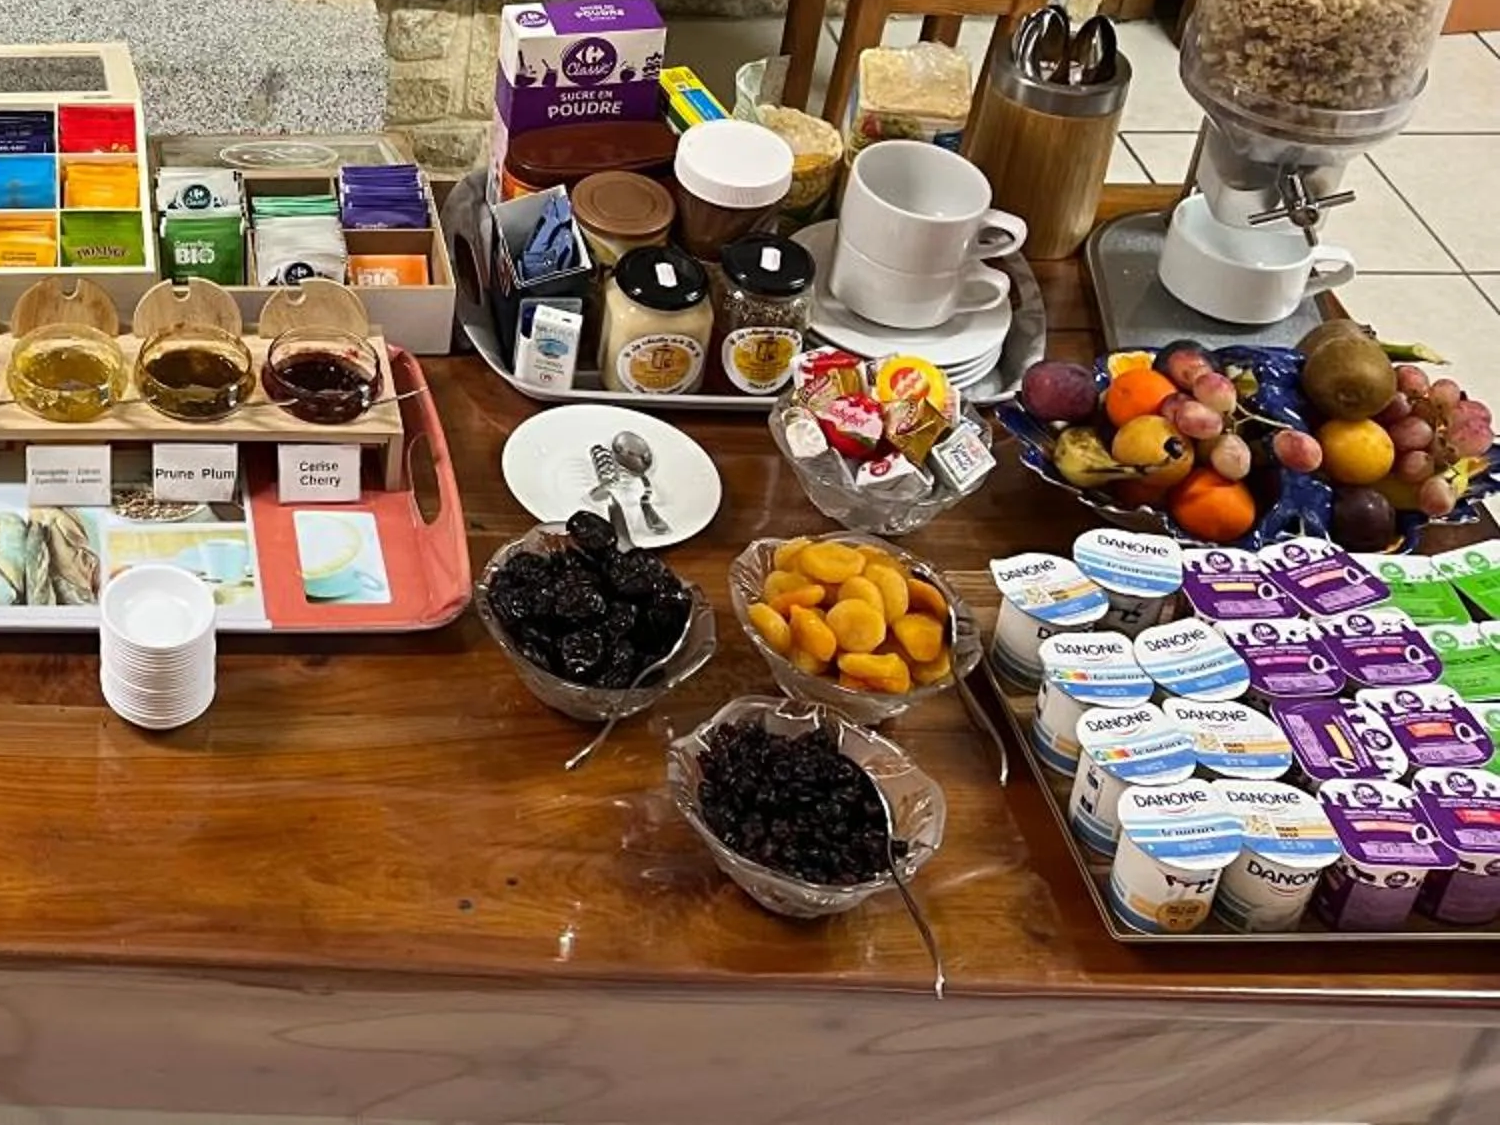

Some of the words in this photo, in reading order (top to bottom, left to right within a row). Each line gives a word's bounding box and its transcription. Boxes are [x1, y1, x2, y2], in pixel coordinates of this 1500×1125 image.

[560, 90, 595, 102] SUCRE
[598, 90, 613, 100] EN
[547, 101, 623, 120] POUDRE
[77, 246, 127, 259] TWININGS
[175, 248, 215, 265] BIO
[299, 461, 339, 472] Cerise
[155, 468, 195, 480] Prune
[201, 468, 235, 480] Plum
[299, 475, 340, 488] Cherry
[1097, 534, 1169, 556] DANONE
[998, 559, 1057, 582] DANONE
[1144, 628, 1207, 652] DANONE
[1054, 642, 1124, 655] DANONE
[1085, 710, 1152, 733] DANONE
[1176, 708, 1248, 722] DANONE
[1133, 790, 1208, 808] DANONE
[1225, 790, 1301, 804] DANONE
